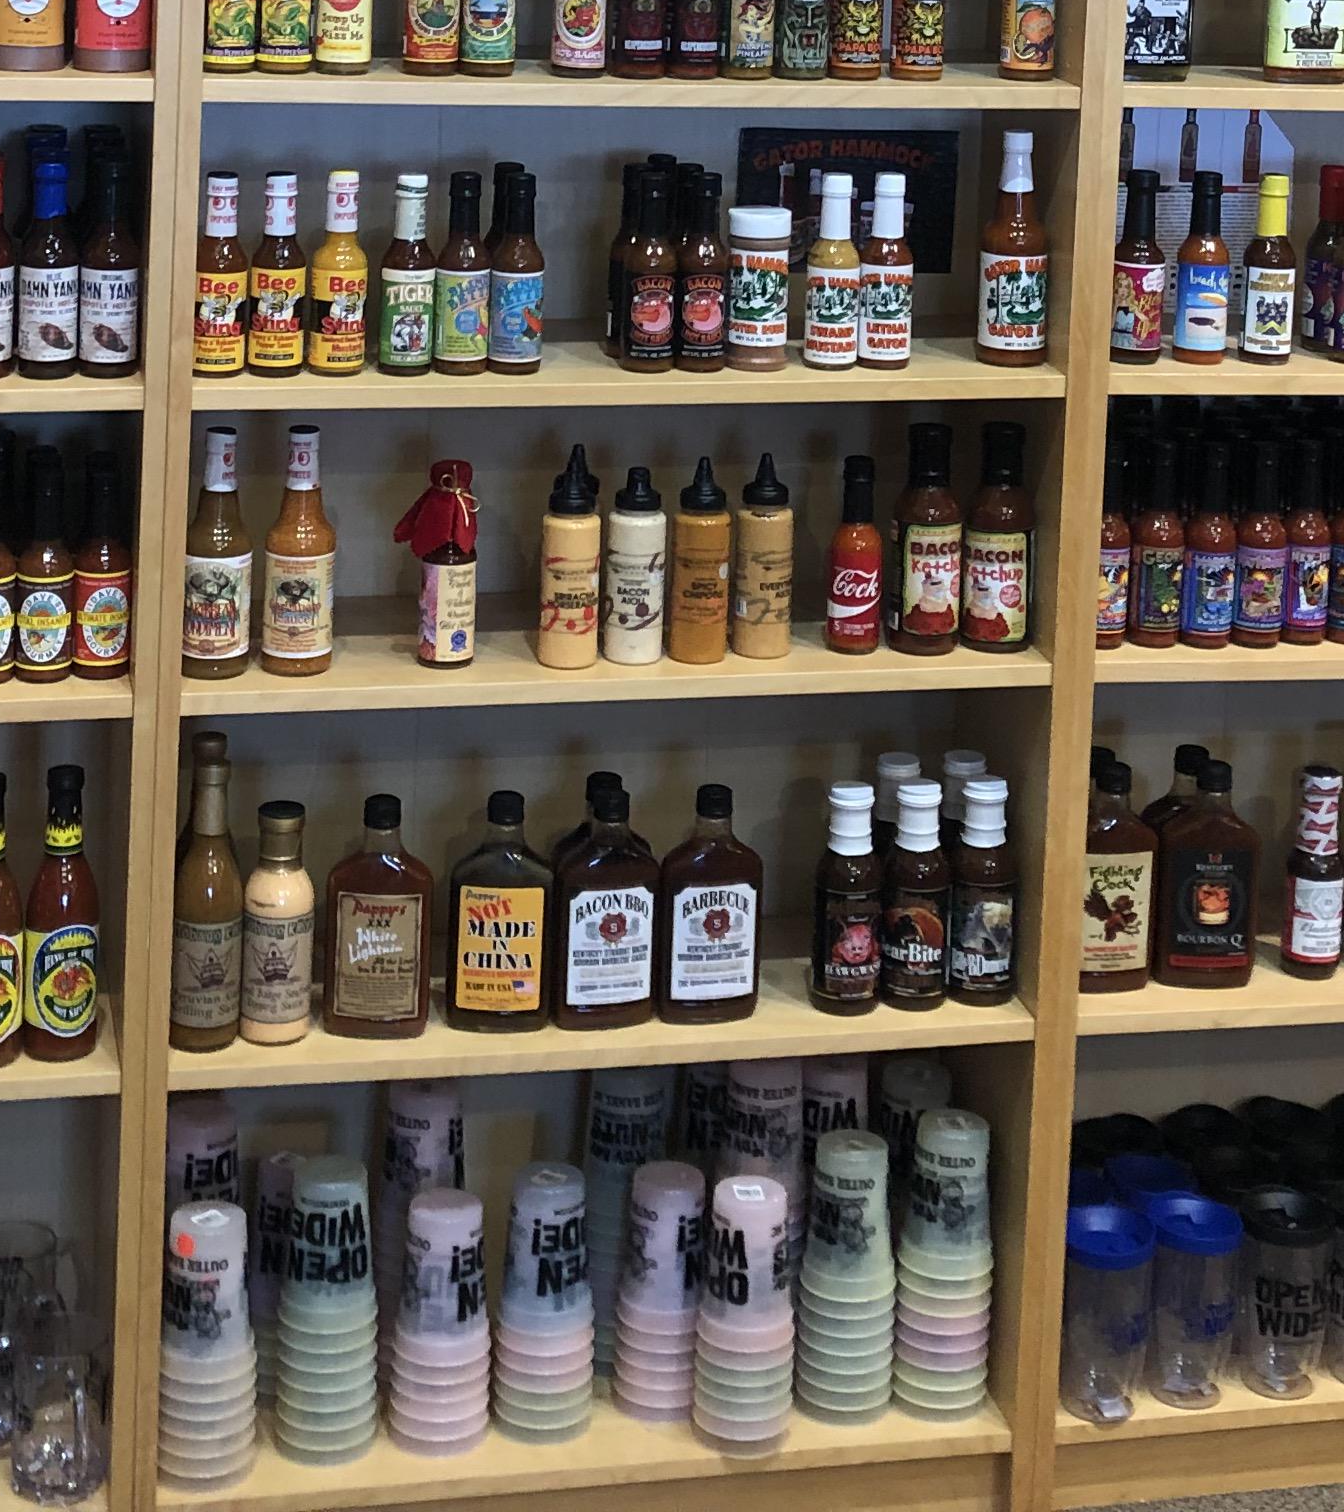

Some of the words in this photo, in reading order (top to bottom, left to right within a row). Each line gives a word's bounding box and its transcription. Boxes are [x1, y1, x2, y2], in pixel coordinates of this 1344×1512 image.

[199, 278, 240, 295] Bee
[257, 274, 296, 291] Bee
[329, 276, 366, 293] Bee
[386, 283, 433, 305] TIGER
[1142, 549, 1182, 565] GEOR
[832, 568, 879, 599] Cock
[1089, 866, 1143, 883] Fighting
[1093, 878, 1134, 892] Cock
[466, 898, 512, 921] NOT
[575, 896, 621, 923] BACON
[625, 894, 649, 919] BBQ
[682, 890, 750, 918] BARBECUE
[468, 919, 536, 938] MADE
[492, 939, 508, 951] IN
[1231, 934, 1244, 948] Q
[463, 952, 532, 970] CHINA
